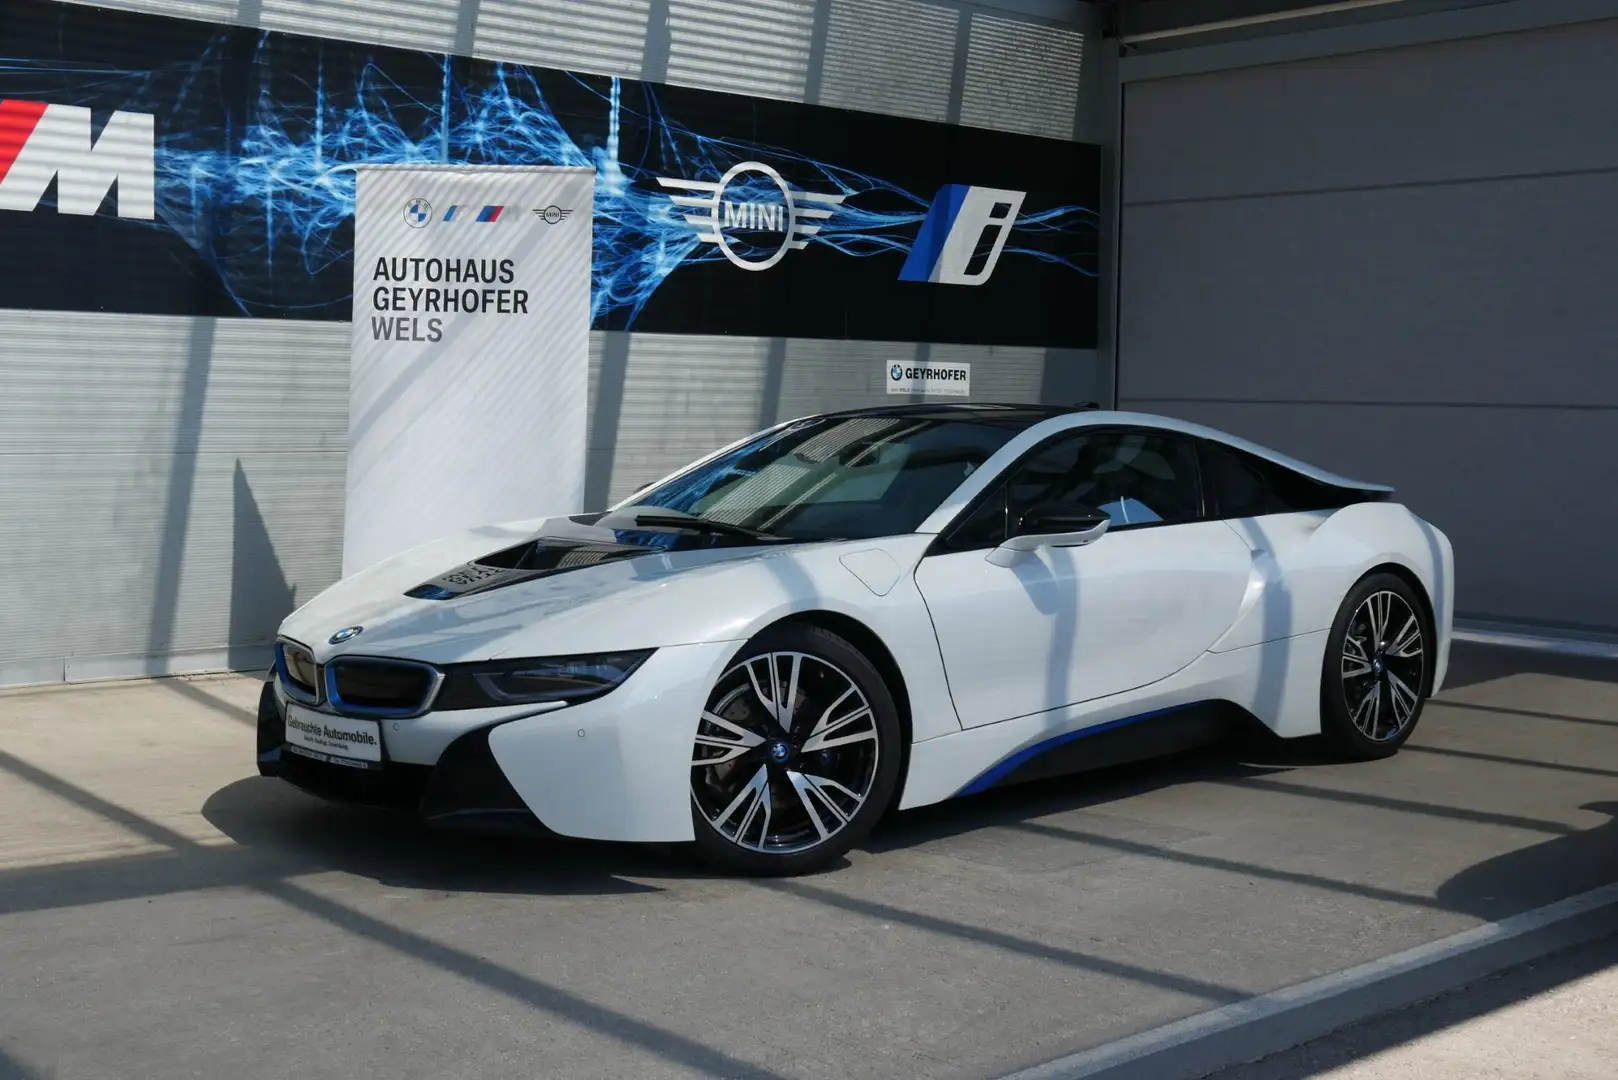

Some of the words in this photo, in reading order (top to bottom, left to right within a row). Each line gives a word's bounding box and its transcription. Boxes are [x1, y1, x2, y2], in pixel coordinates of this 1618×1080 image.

[0, 103, 155, 220] M
[724, 200, 784, 232] MINI
[372, 256, 515, 284] AUTOHAUS
[372, 286, 529, 314] GEYRHOFER
[371, 316, 443, 343] WELS
[905, 367, 967, 381] GEYRHOFER
[287, 714, 322, 736] Gebrauchte
[323, 725, 378, 746] Automobile.
